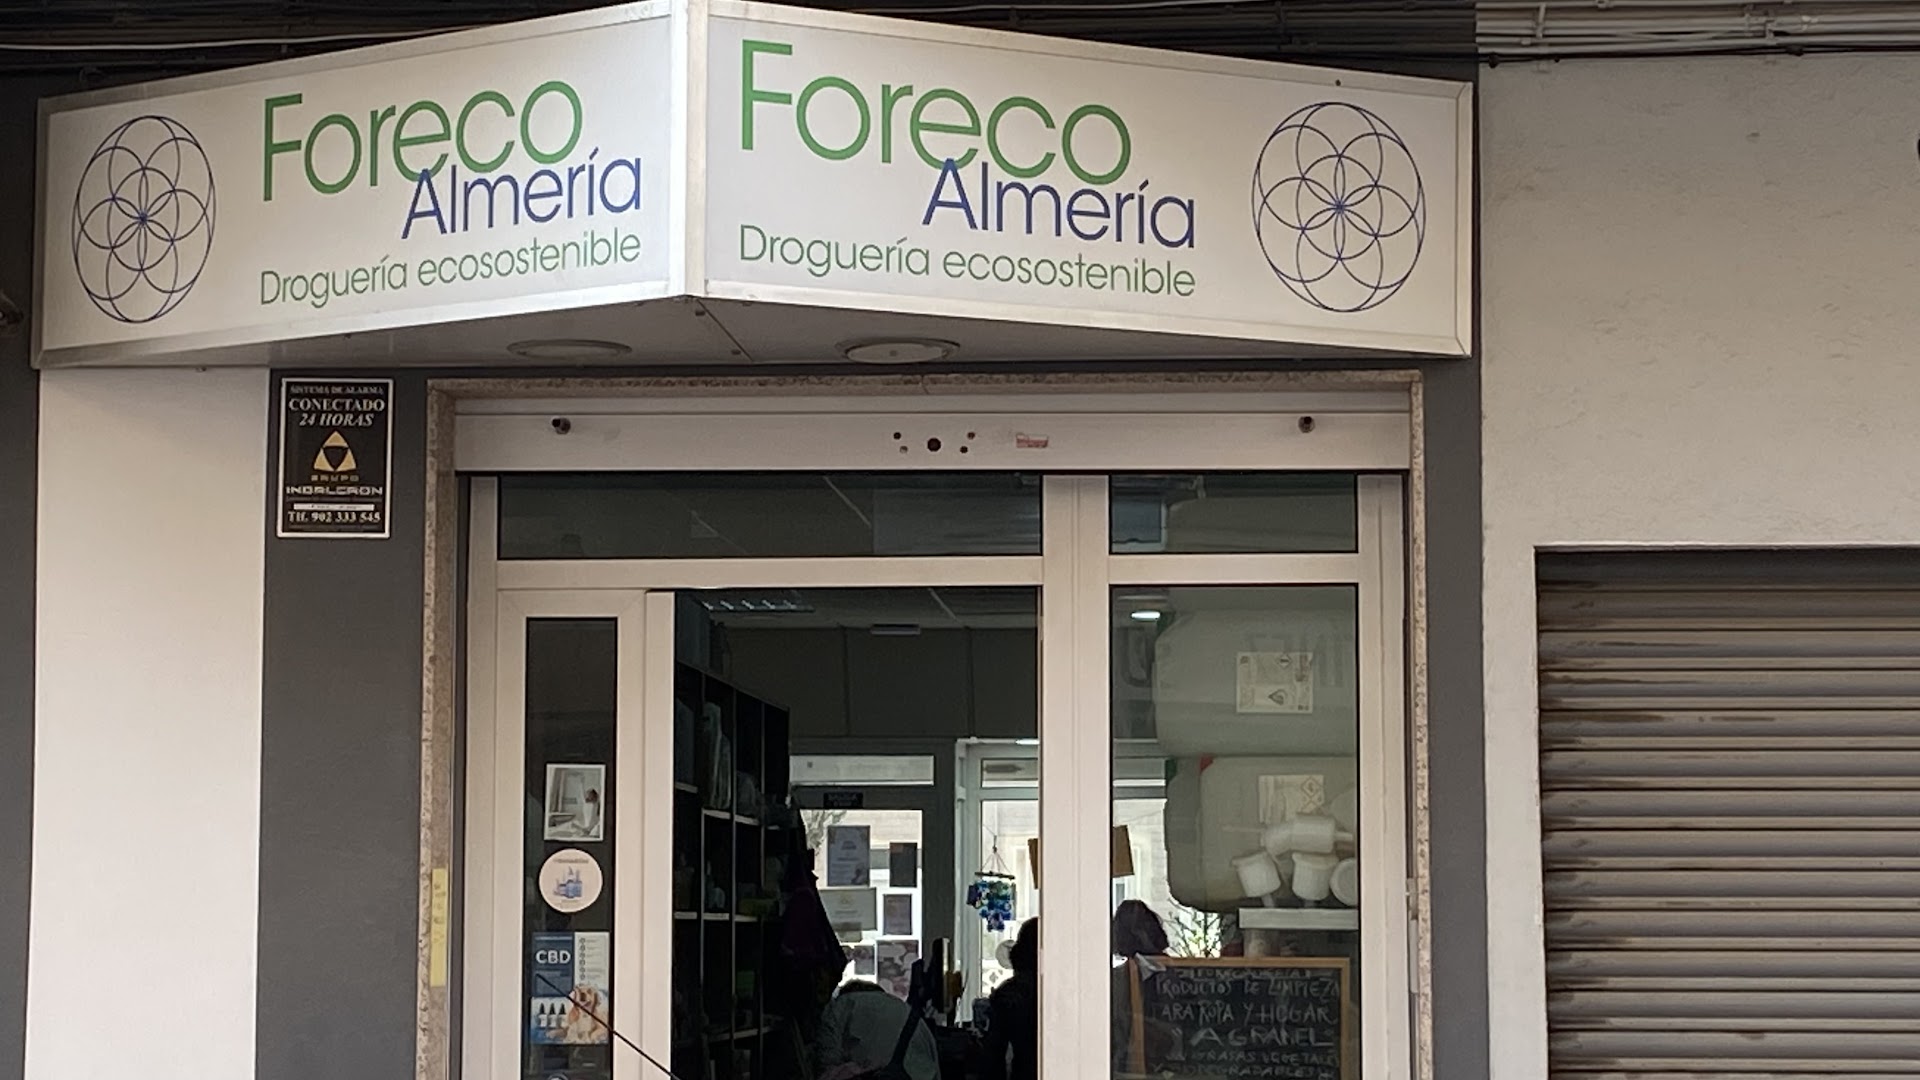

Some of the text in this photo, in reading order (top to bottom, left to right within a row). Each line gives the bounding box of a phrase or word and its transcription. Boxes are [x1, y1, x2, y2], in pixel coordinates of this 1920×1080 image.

[742, 40, 1131, 185] Foreco
[263, 81, 583, 201] Foreco
[402, 147, 641, 239] Almería
[922, 158, 1195, 248] Almería
[260, 227, 641, 309] Droguería ecosostenible
[739, 224, 1195, 297] Droguería ecosostenible
[288, 397, 386, 411] CONECTADO
[299, 413, 375, 427] 24 HORAS
[311, 511, 333, 524] 902
[534, 949, 572, 964] CBD
[1155, 974, 1232, 998] PRODUCTOS
[1268, 977, 1339, 1001] LIMPIEZA
[1255, 1000, 1338, 1025] HOGAR
[1189, 1027, 1224, 1047] A
